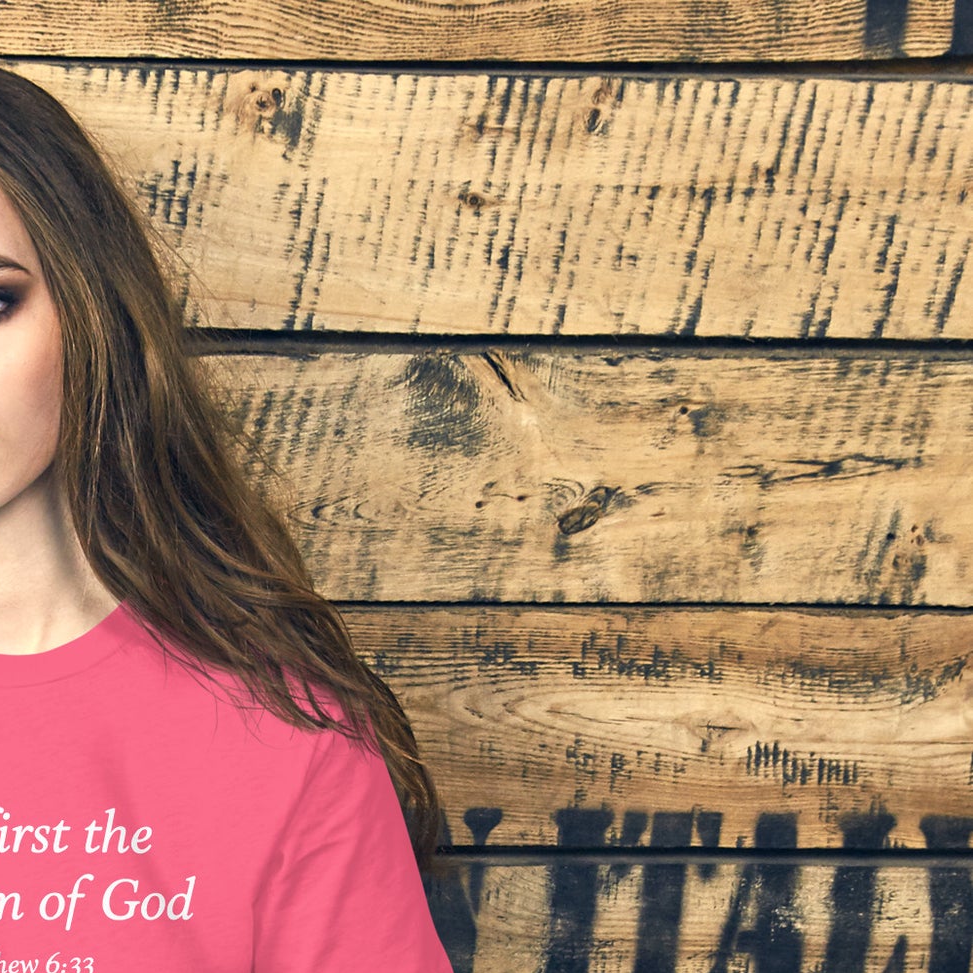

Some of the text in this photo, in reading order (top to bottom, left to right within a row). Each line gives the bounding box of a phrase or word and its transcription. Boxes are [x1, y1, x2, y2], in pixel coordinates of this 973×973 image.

[84, 807, 153, 854] the
[38, 873, 95, 931] of
[101, 875, 197, 921] God
